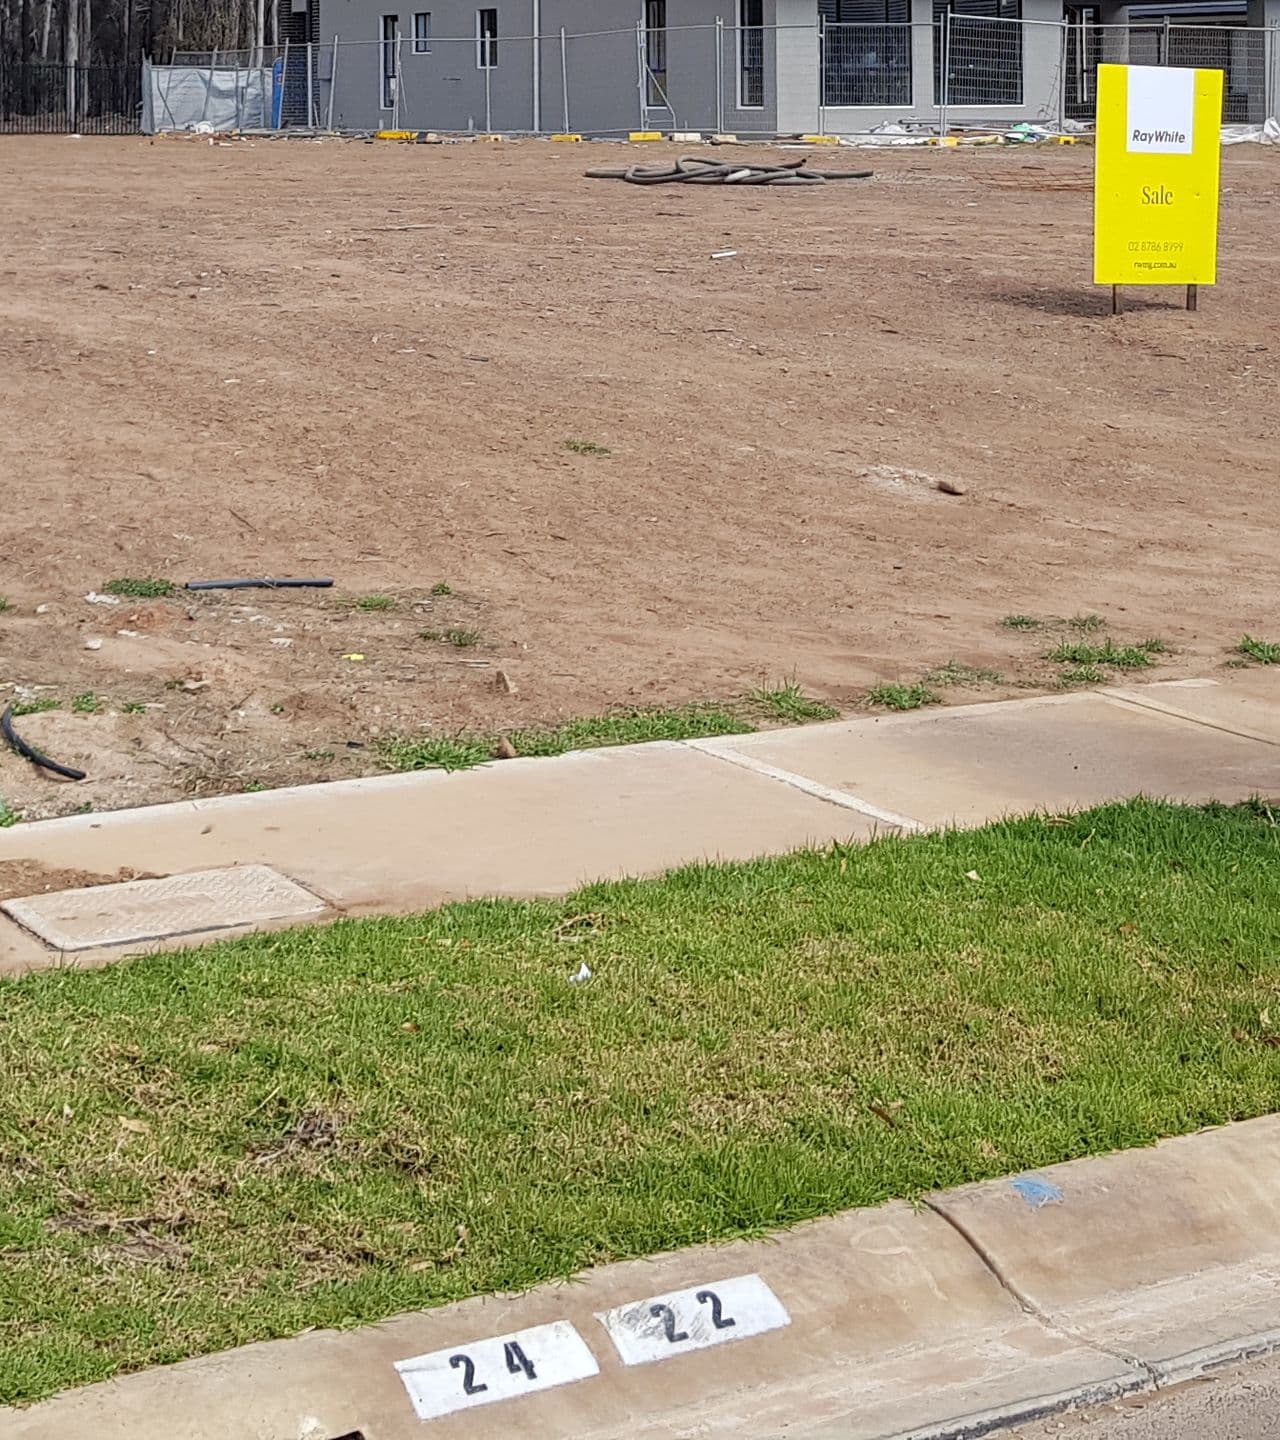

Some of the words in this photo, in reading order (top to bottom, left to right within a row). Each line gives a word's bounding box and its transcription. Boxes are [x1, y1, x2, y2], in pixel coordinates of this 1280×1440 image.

[1141, 185, 1174, 206] Sale
[1128, 241, 1140, 252] 02
[649, 1289, 737, 1344] 22
[448, 1340, 538, 1396] 24
